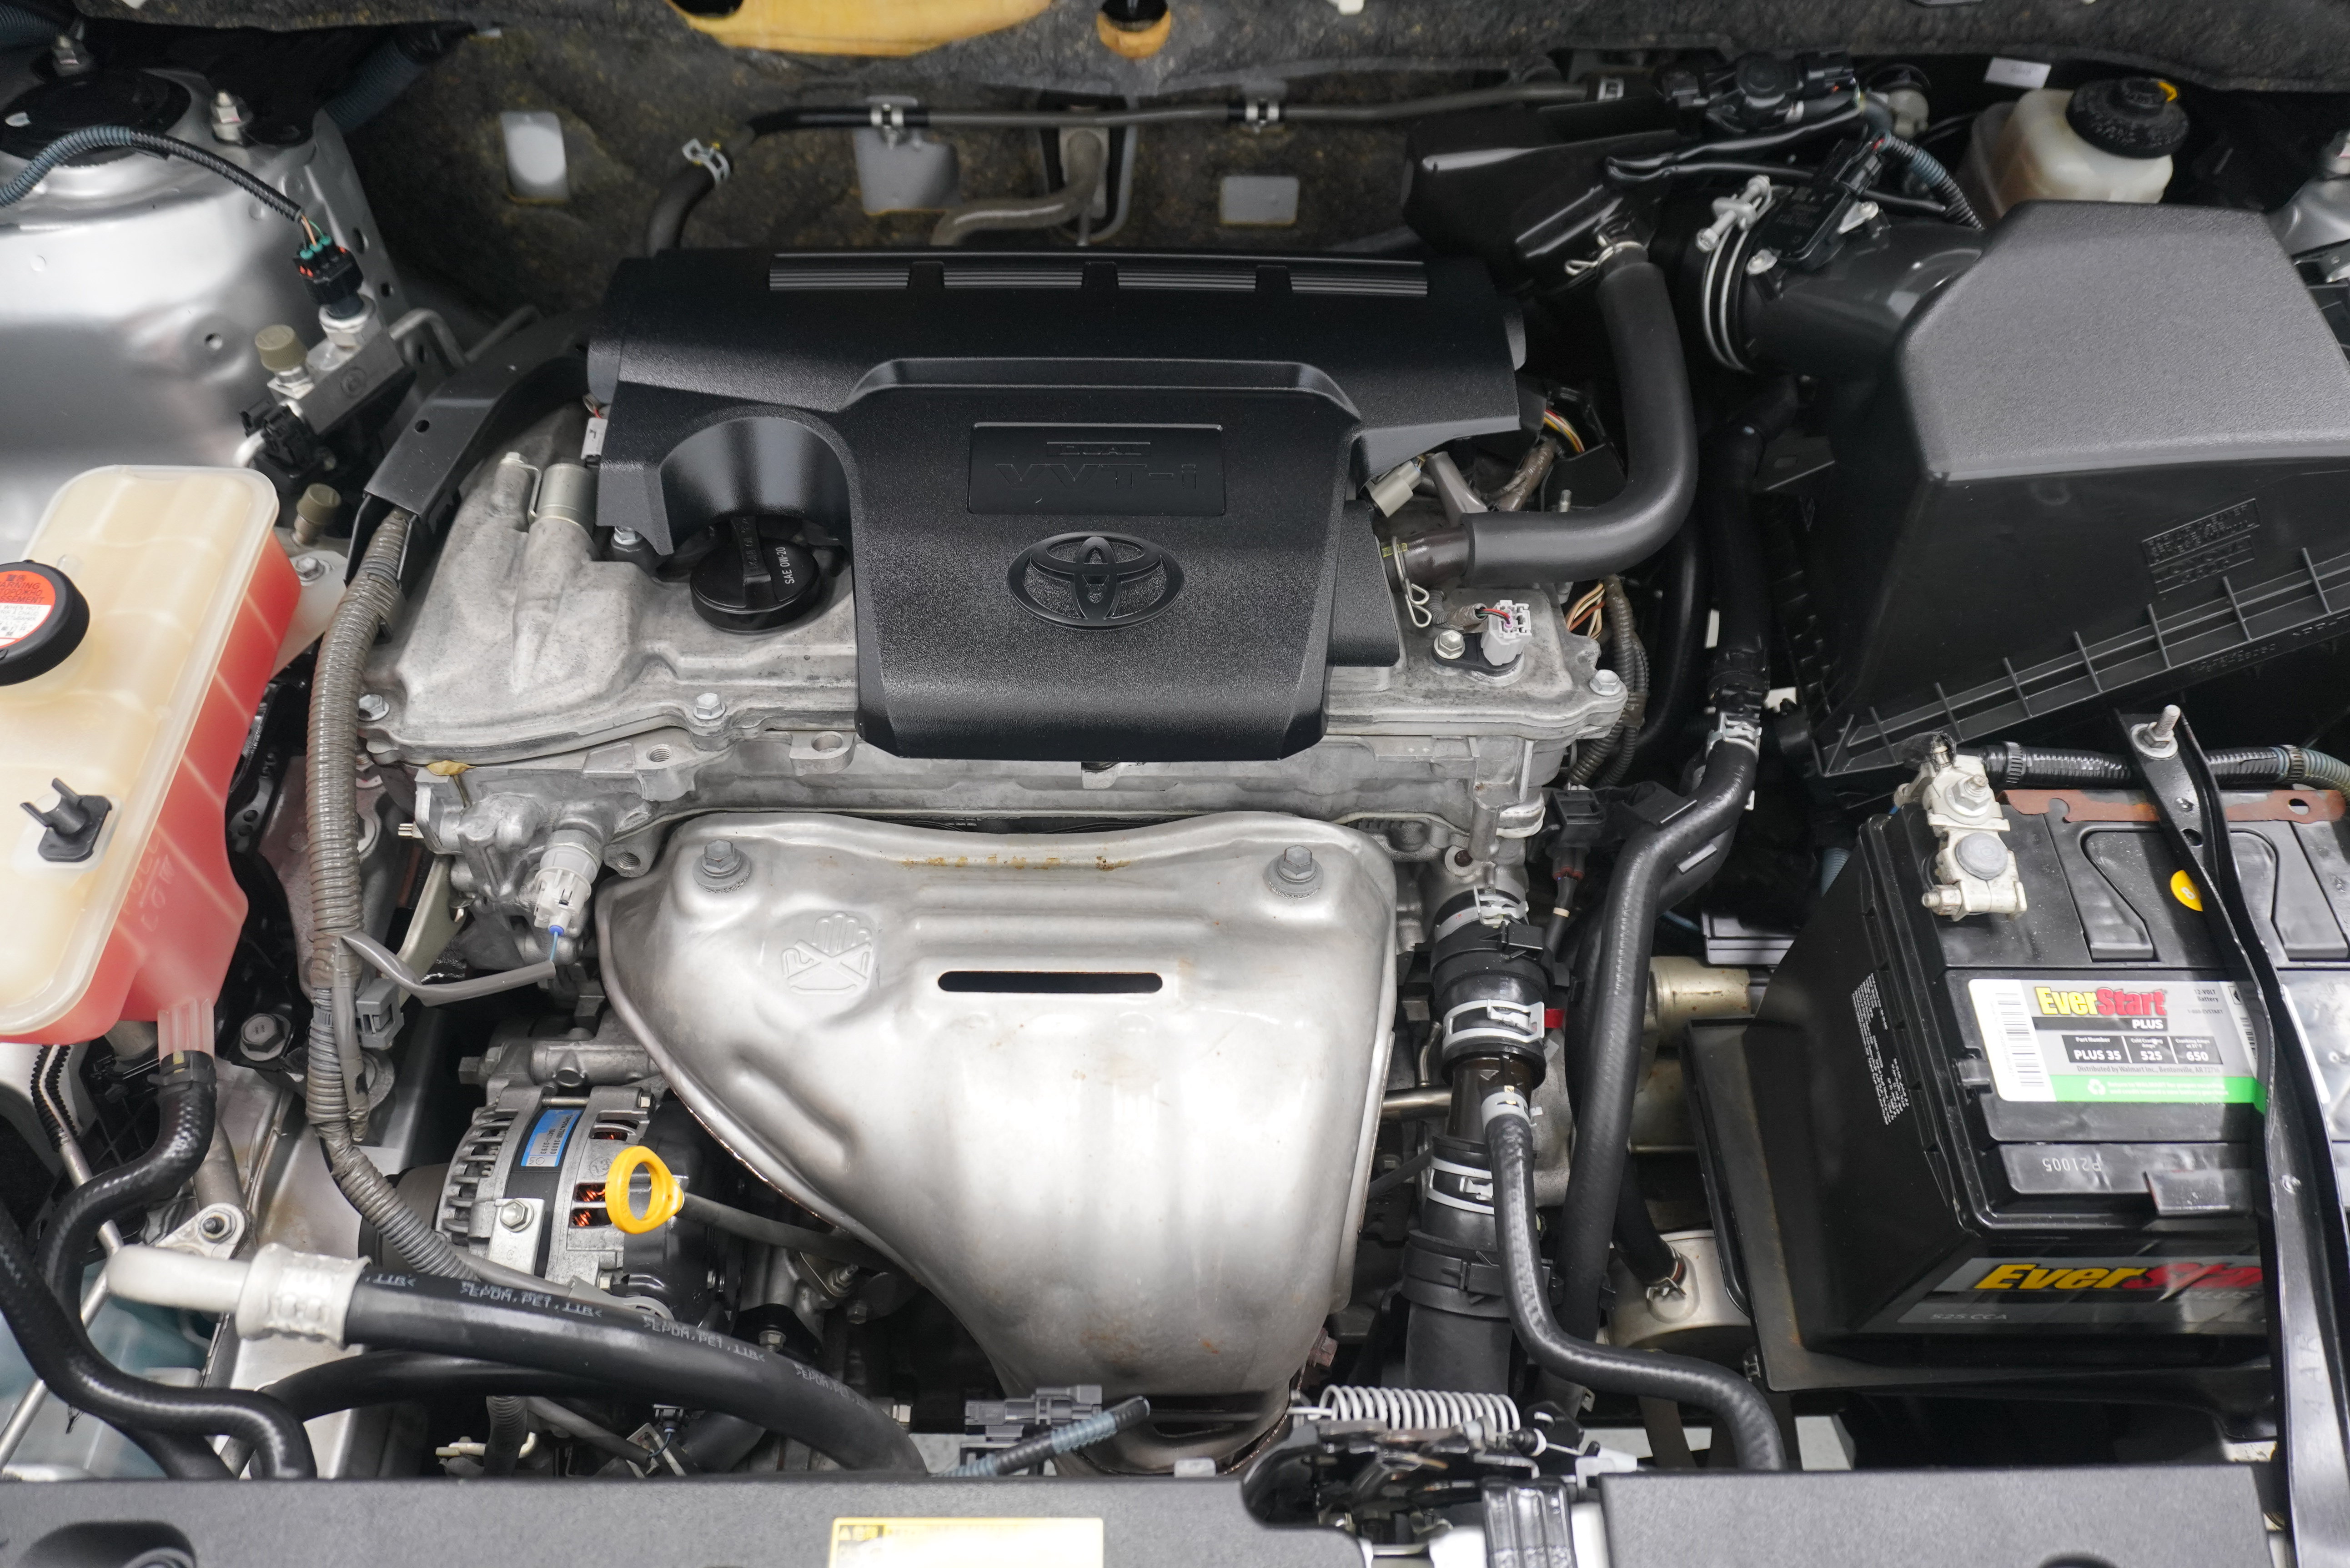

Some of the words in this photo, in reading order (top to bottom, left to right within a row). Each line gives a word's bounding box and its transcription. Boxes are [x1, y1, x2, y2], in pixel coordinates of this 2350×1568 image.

[995, 463, 1197, 489] VVT-i
[775, 547, 790, 567] 0W-20
[782, 569, 795, 584] SAE
[2034, 986, 2167, 1016] EverStart
[2132, 1019, 2164, 1029] PLUS
[2074, 1049, 2104, 1060] PLUS
[2106, 1050, 2122, 1060] 35
[2140, 1051, 2163, 1060] 525
[2186, 1051, 2209, 1061] 650
